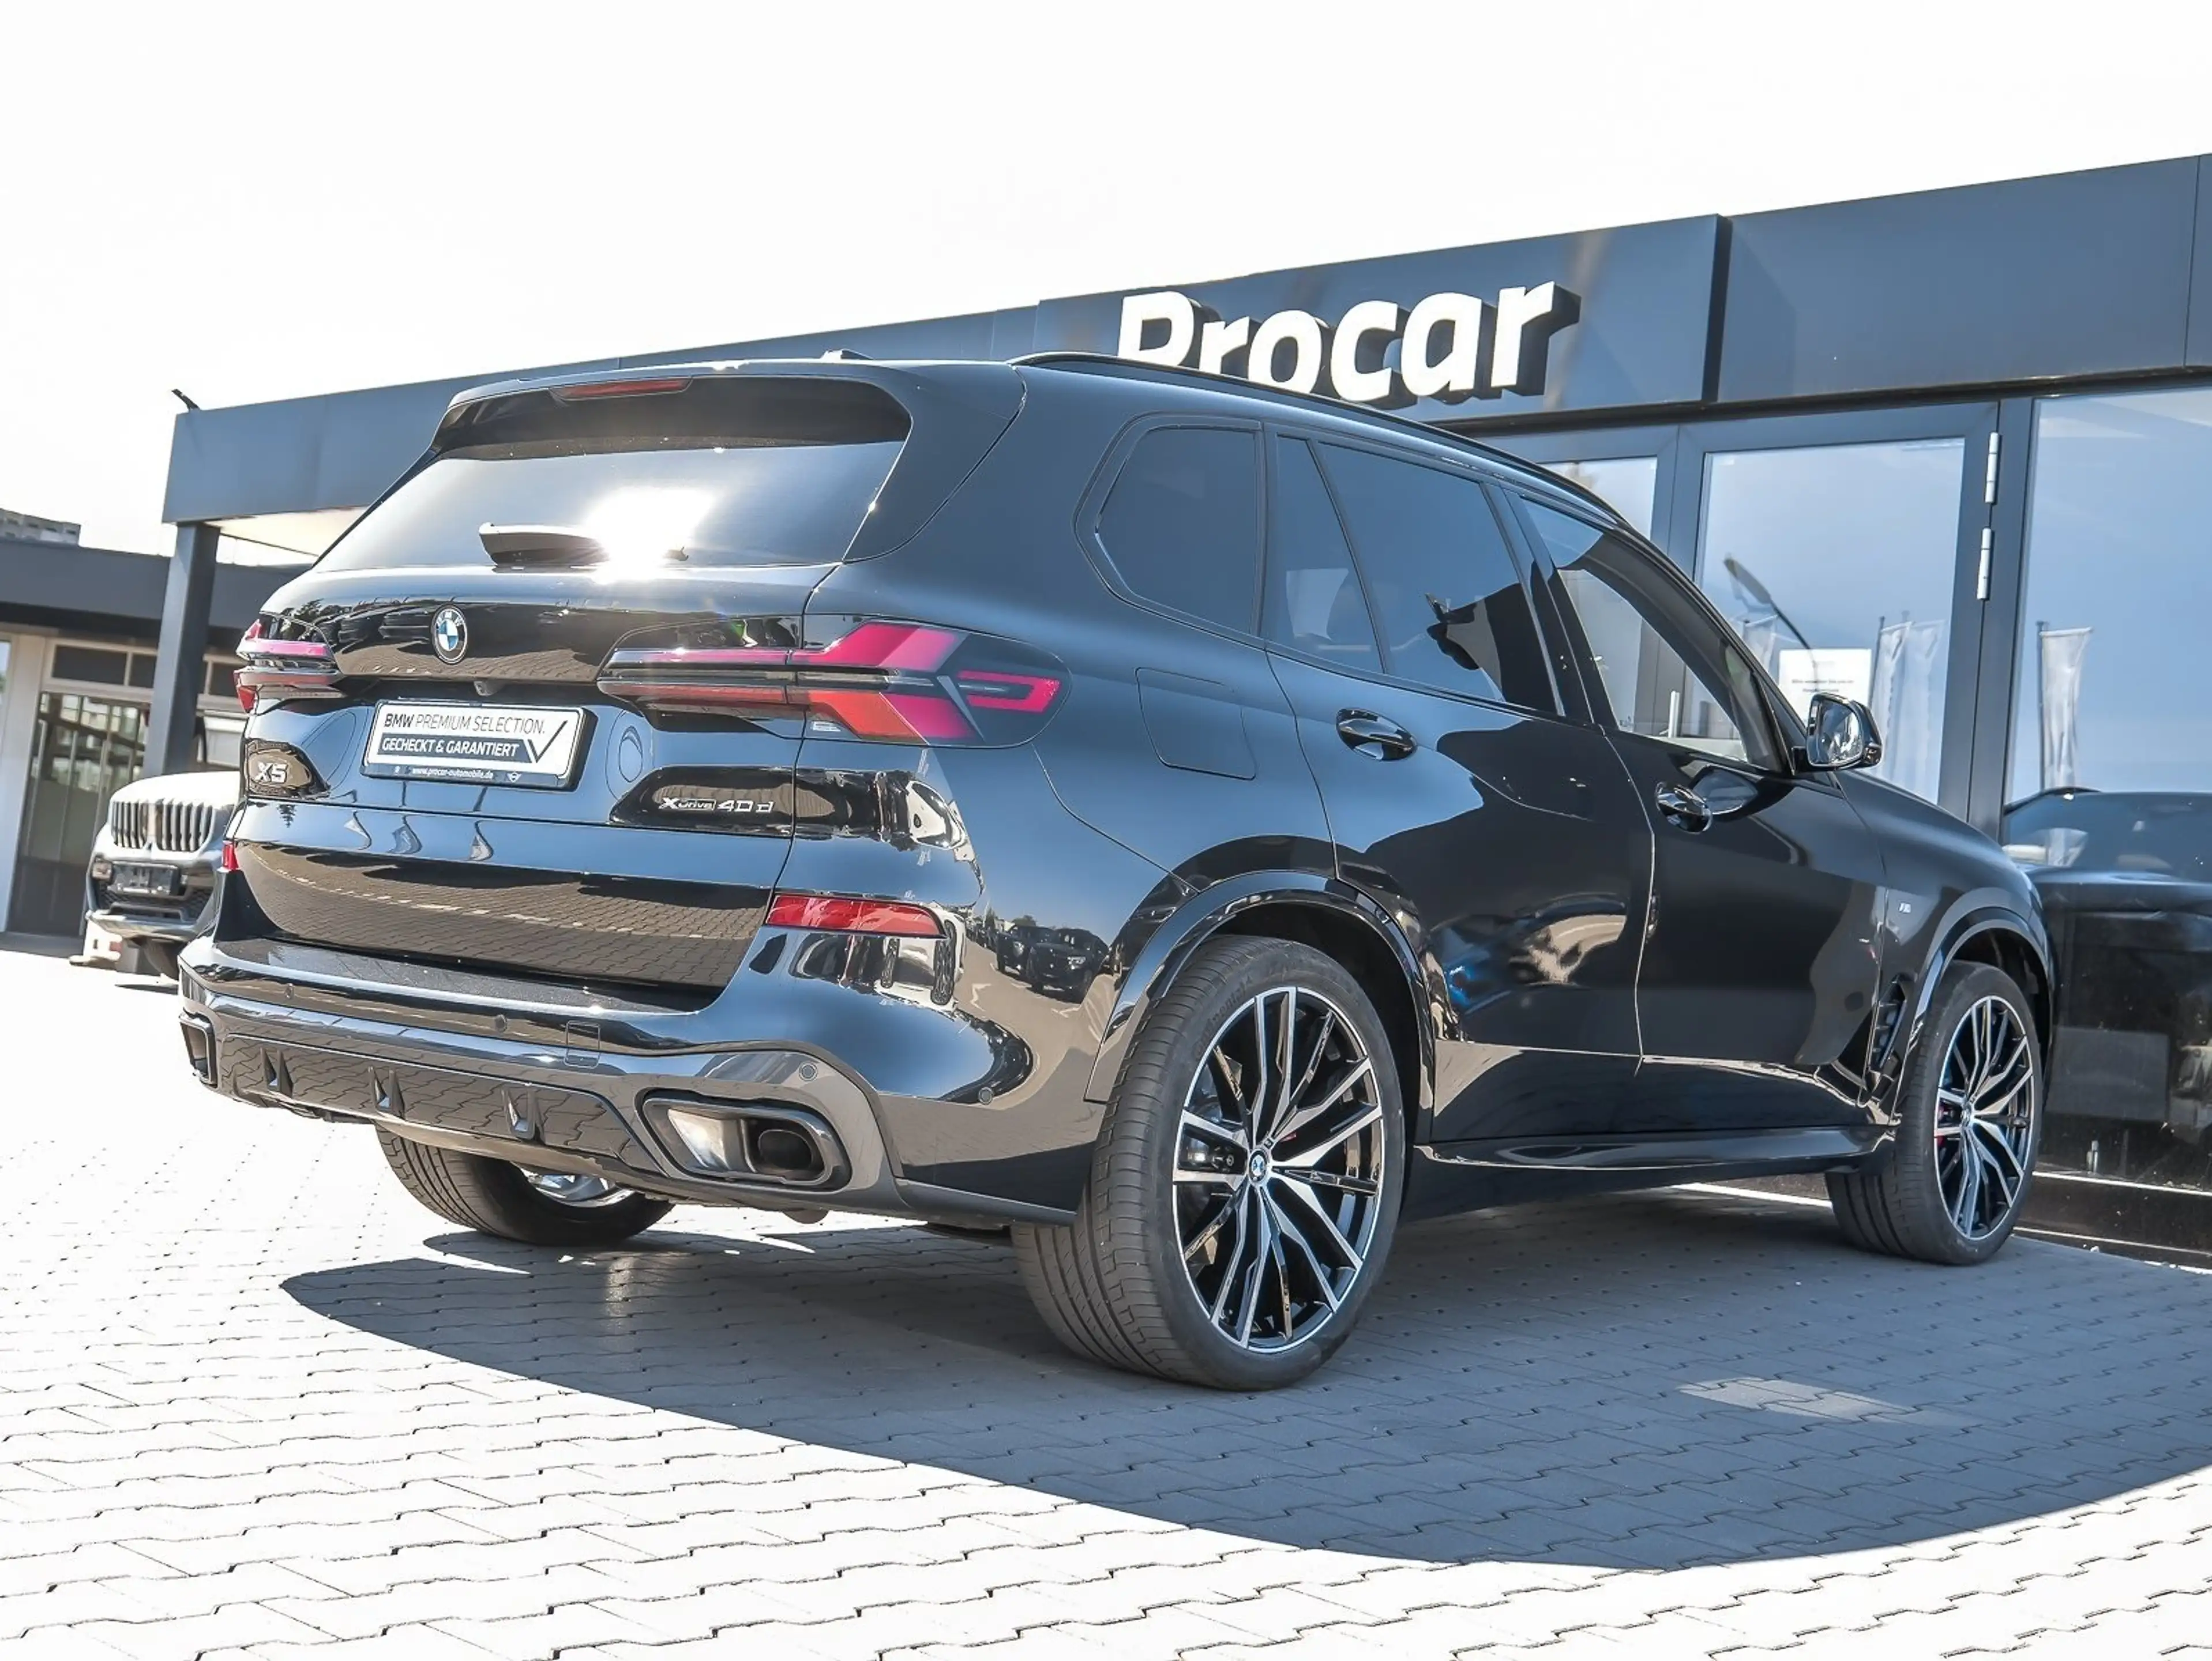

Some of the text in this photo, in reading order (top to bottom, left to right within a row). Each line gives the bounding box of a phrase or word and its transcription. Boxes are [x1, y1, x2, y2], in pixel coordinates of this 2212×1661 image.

[1117, 280, 1556, 401] Procar
[384, 713, 545, 734] BMW PREMIUM SELECTION.
[382, 738, 520, 757] GECHECKT & GARANTIERT
[253, 761, 288, 783] X5
